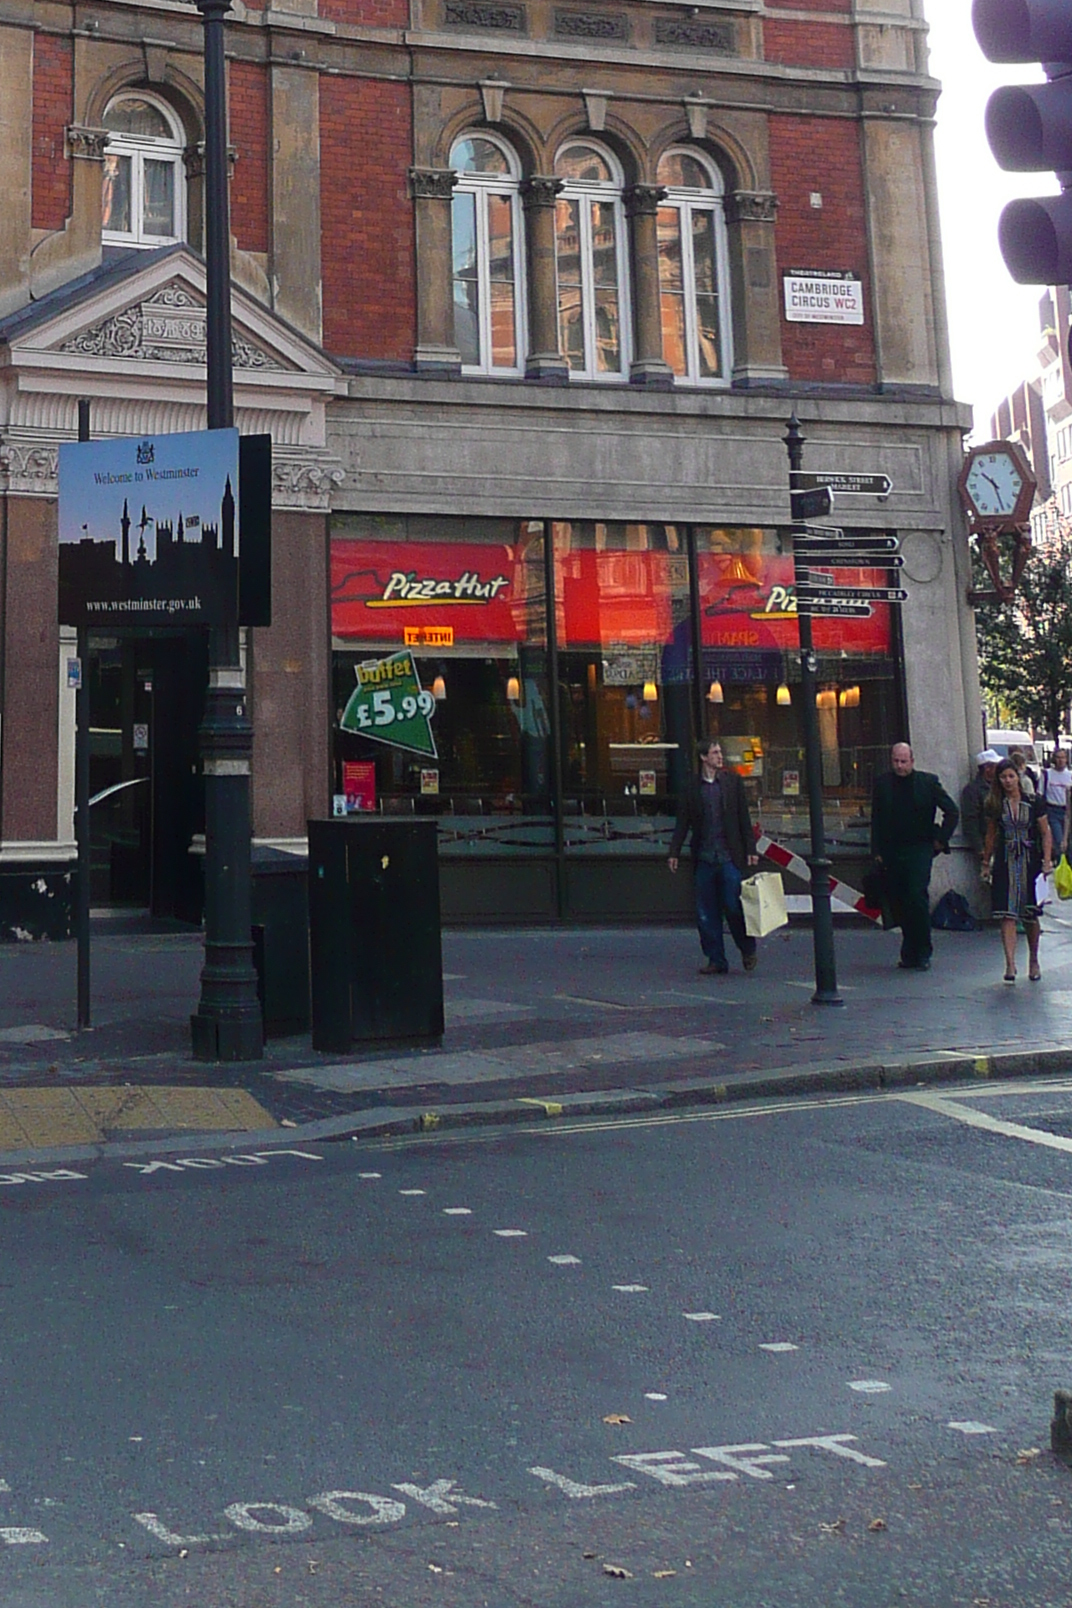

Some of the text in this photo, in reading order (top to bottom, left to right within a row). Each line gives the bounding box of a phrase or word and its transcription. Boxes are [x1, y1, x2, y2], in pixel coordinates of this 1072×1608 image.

[791, 282, 853, 297] CAMBRIDGE
[791, 295, 857, 310] CIRCUS WC2
[93, 467, 200, 485] Welcome to Westminster
[383, 572, 510, 600] Pizza Hut
[86, 595, 202, 614] www.westminster.gov.uk
[357, 659, 412, 684] buffet
[236, 705, 243, 716] 6
[357, 690, 432, 728] £5.99
[122, 1149, 324, 1174] LOOK
[129, 1433, 888, 1546] LOOK LEFT
